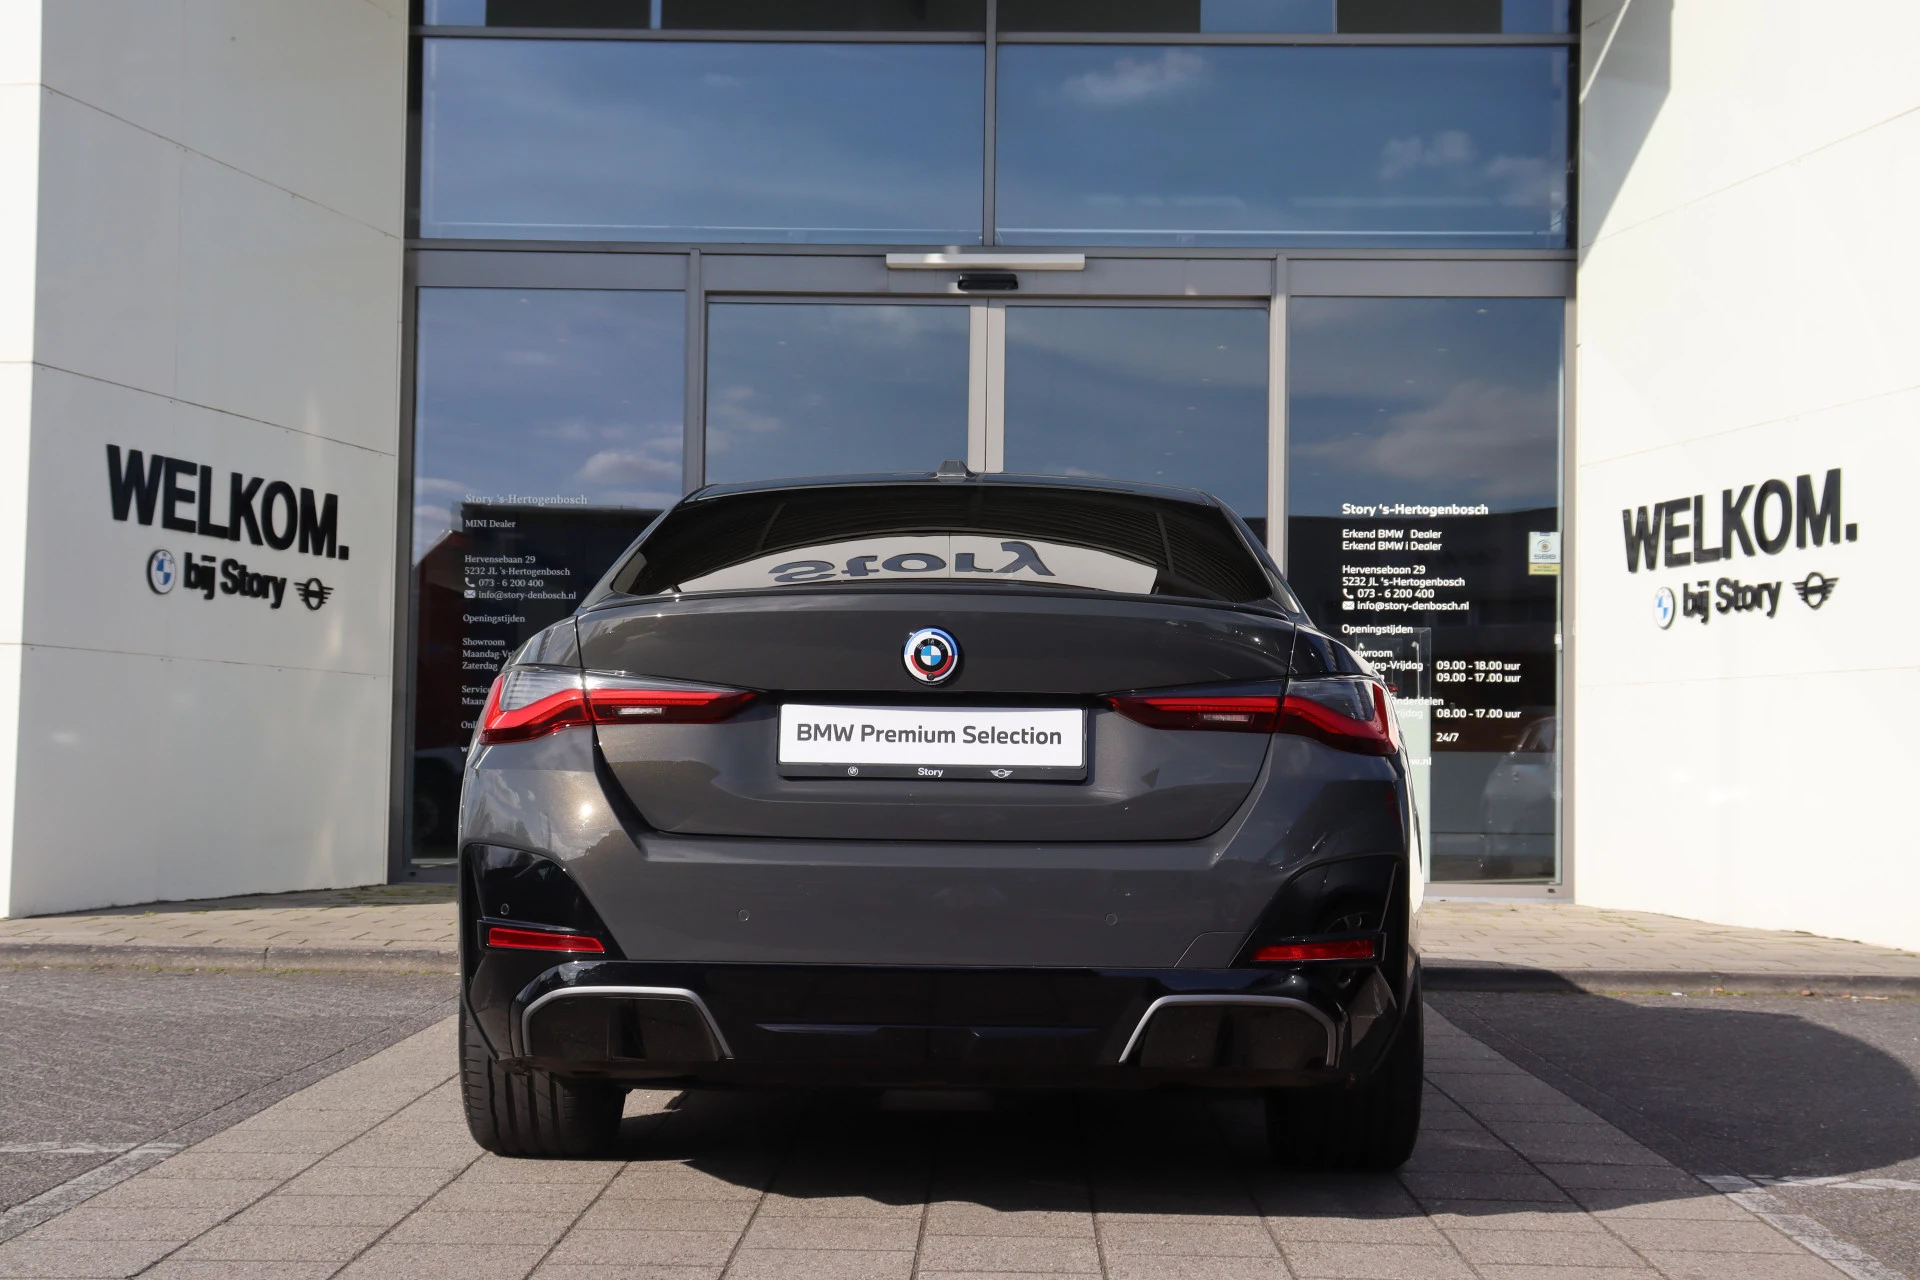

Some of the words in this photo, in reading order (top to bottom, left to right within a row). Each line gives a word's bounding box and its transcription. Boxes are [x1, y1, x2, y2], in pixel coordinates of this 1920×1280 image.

[106, 444, 349, 560] WELKOM.
[465, 494, 493, 505] Story
[1342, 503, 1376, 517] Story
[465, 519, 487, 528] MINI
[489, 519, 516, 528] Dealer
[1622, 468, 1858, 573] WELKOM.
[1342, 529, 1376, 539] Erkend
[1377, 529, 1404, 539] BMW
[1410, 529, 1443, 539] Dealer
[1342, 541, 1376, 551] Erkend
[1377, 541, 1404, 551] BMW
[1405, 541, 1409, 551] i
[1410, 541, 1443, 551] Dealer
[464, 555, 523, 564] Hervensebaan
[525, 555, 536, 564] 29
[464, 567, 486, 576] 5232
[487, 567, 498, 576] JL
[1342, 565, 1412, 575] Hervensebaan
[1413, 565, 1426, 575] 29
[184, 552, 216, 600] bij
[220, 558, 287, 609] Story
[478, 579, 495, 587] 073
[502, 579, 508, 587] 6
[509, 579, 526, 587] 200
[527, 580, 544, 588] 400
[1342, 577, 1367, 587] 5232
[1367, 577, 1379, 587] JL
[478, 590, 577, 600] info@story-denbosch.nl
[1357, 589, 1376, 599] 073
[1384, 589, 1392, 599] 6
[1393, 589, 1413, 599] 200
[1414, 589, 1435, 599] 400
[1683, 580, 1709, 625] bij
[1716, 576, 1782, 619] Story
[1357, 601, 1470, 611] info@story-denbosch.nl
[463, 614, 526, 625] Openingstijden
[1341, 624, 1414, 636] Openingstijden
[462, 637, 506, 646] Showroom
[462, 661, 499, 672] Zaterdag
[1436, 661, 1467, 671] 09.00
[1474, 661, 1503, 671] 18.00
[1504, 663, 1521, 671] uur
[1436, 673, 1467, 683] 09.00
[1504, 675, 1522, 683] uur
[1436, 709, 1467, 719] 08.00
[1504, 711, 1522, 719] uur
[796, 723, 854, 743] BMW
[861, 724, 956, 744] Premium
[963, 725, 1062, 746] Selection
[1436, 733, 1460, 743] 24/7
[917, 766, 944, 778] Story
